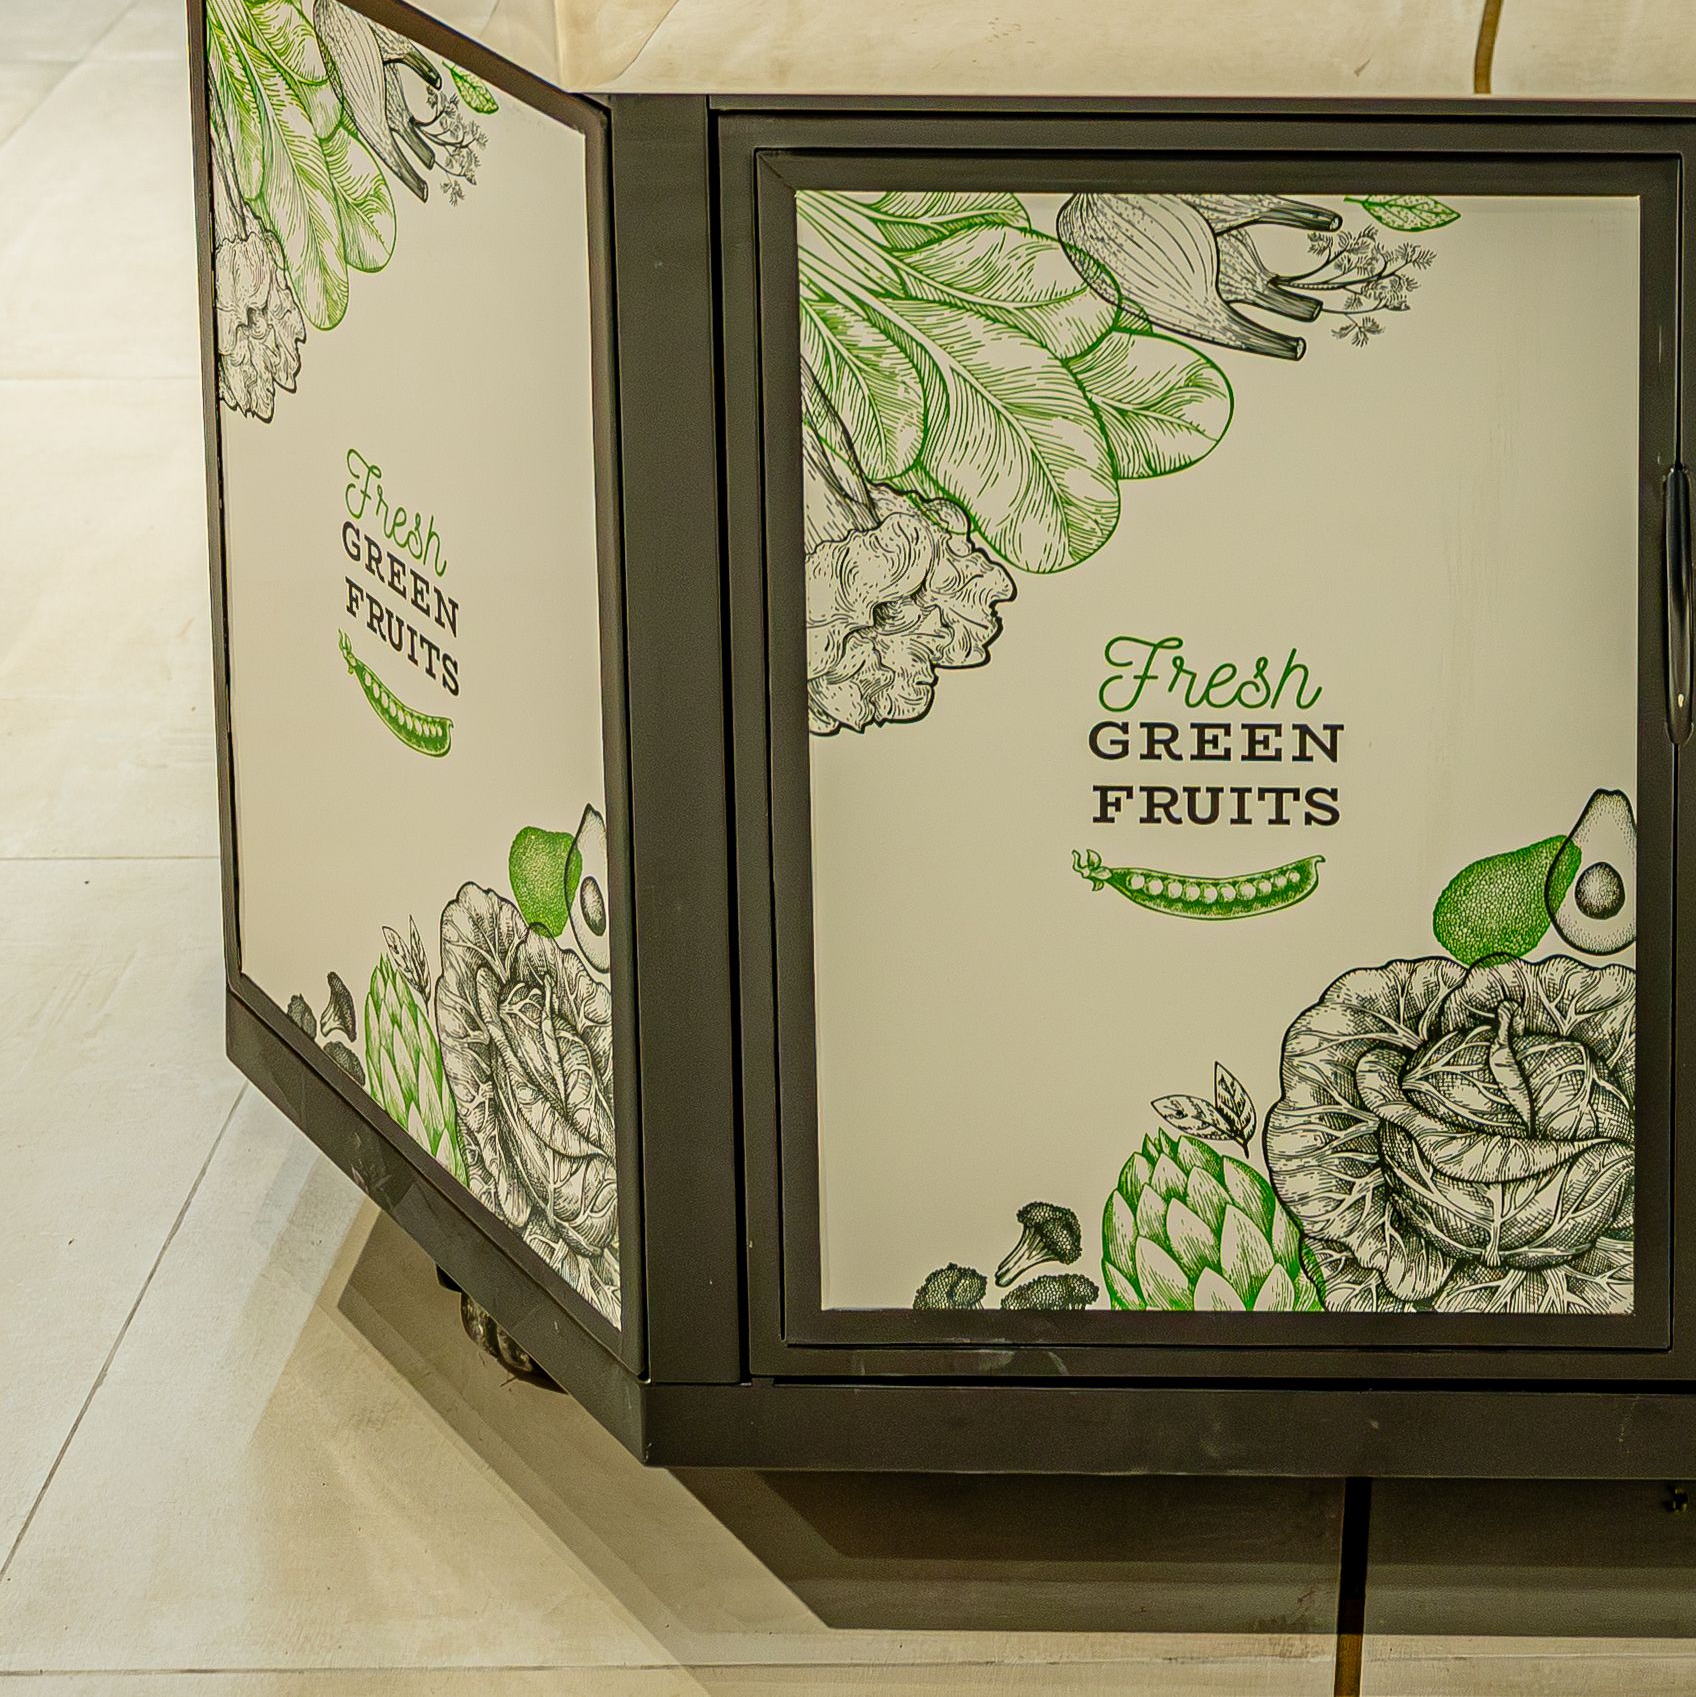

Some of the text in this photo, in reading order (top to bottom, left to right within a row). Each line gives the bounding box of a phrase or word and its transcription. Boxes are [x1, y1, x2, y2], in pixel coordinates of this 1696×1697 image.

[345, 447, 447, 577] Fresh
[341, 520, 459, 638] GREEN
[345, 575, 460, 697] FRUITS
[1098, 635, 1323, 713] Fresh
[1088, 720, 1345, 763] GREEN
[1092, 784, 1341, 826] FRUITS
